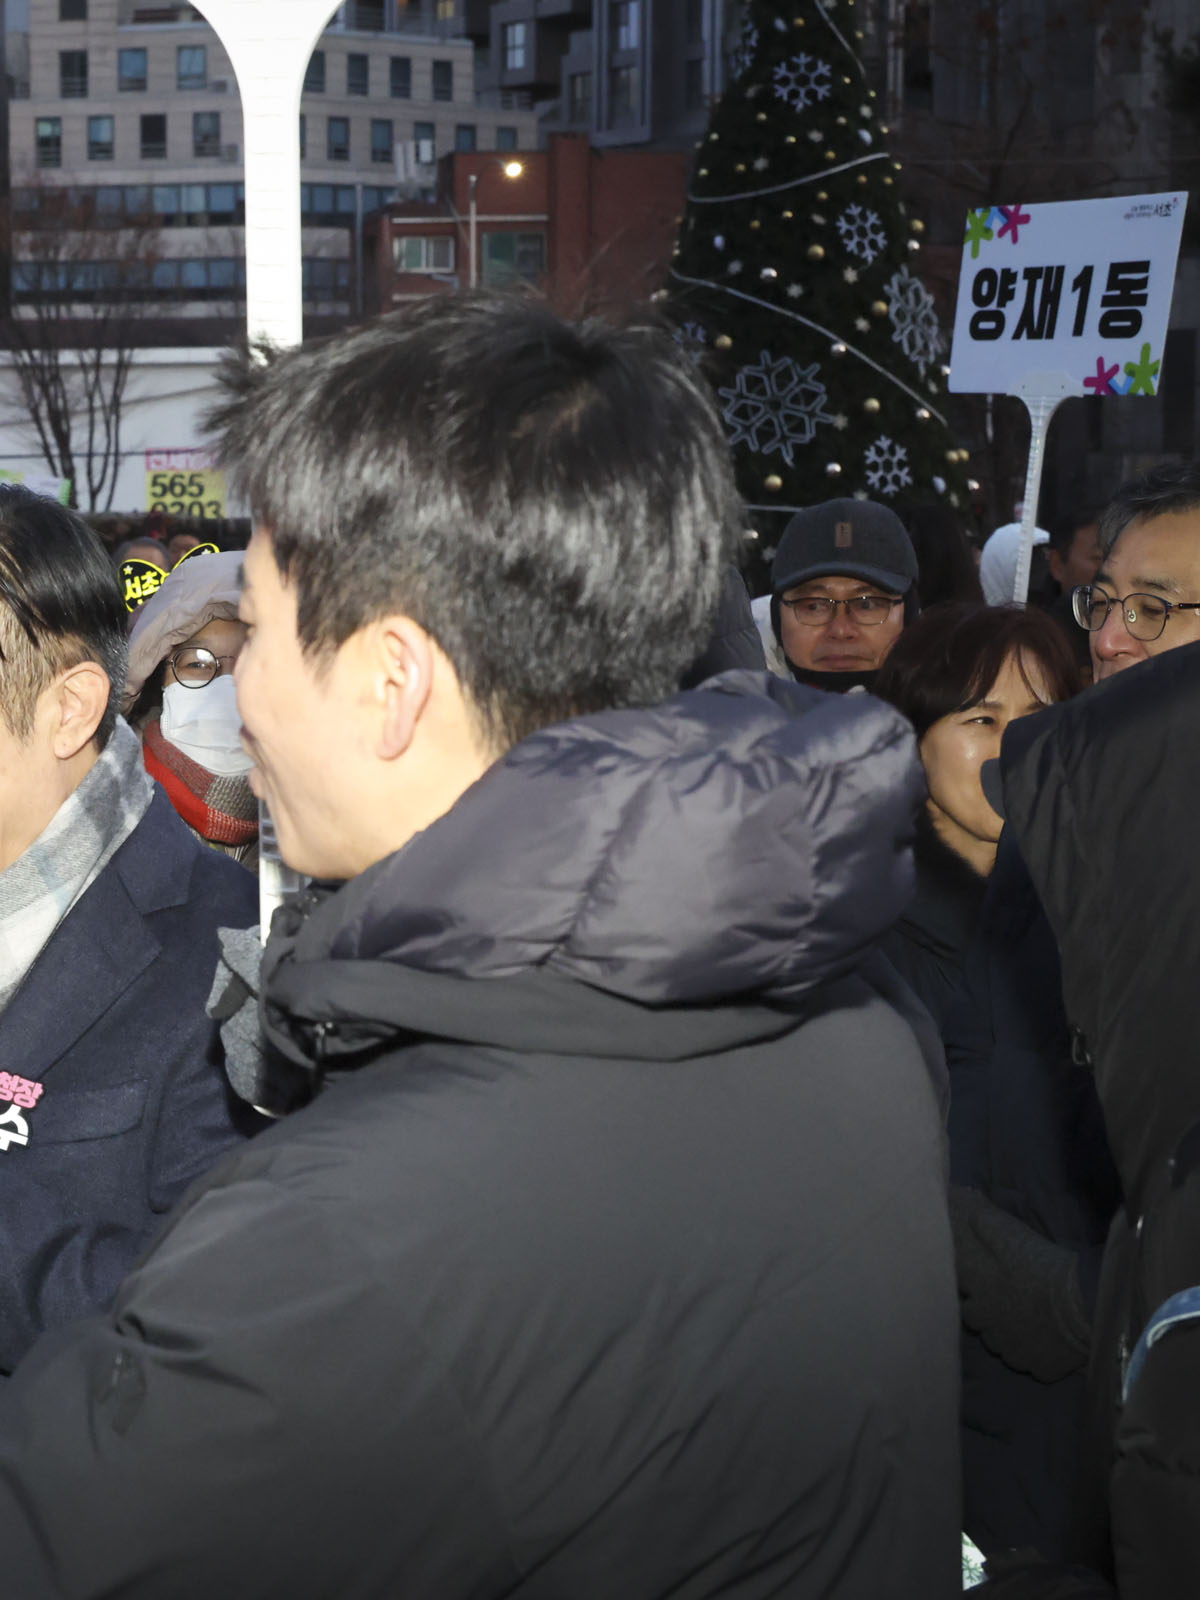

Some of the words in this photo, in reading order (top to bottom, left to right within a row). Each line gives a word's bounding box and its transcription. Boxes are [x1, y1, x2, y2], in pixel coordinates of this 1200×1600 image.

[969, 260, 1151, 341] 양재1동
[151, 474, 205, 498] 565
[125, 571, 160, 601] 서초
